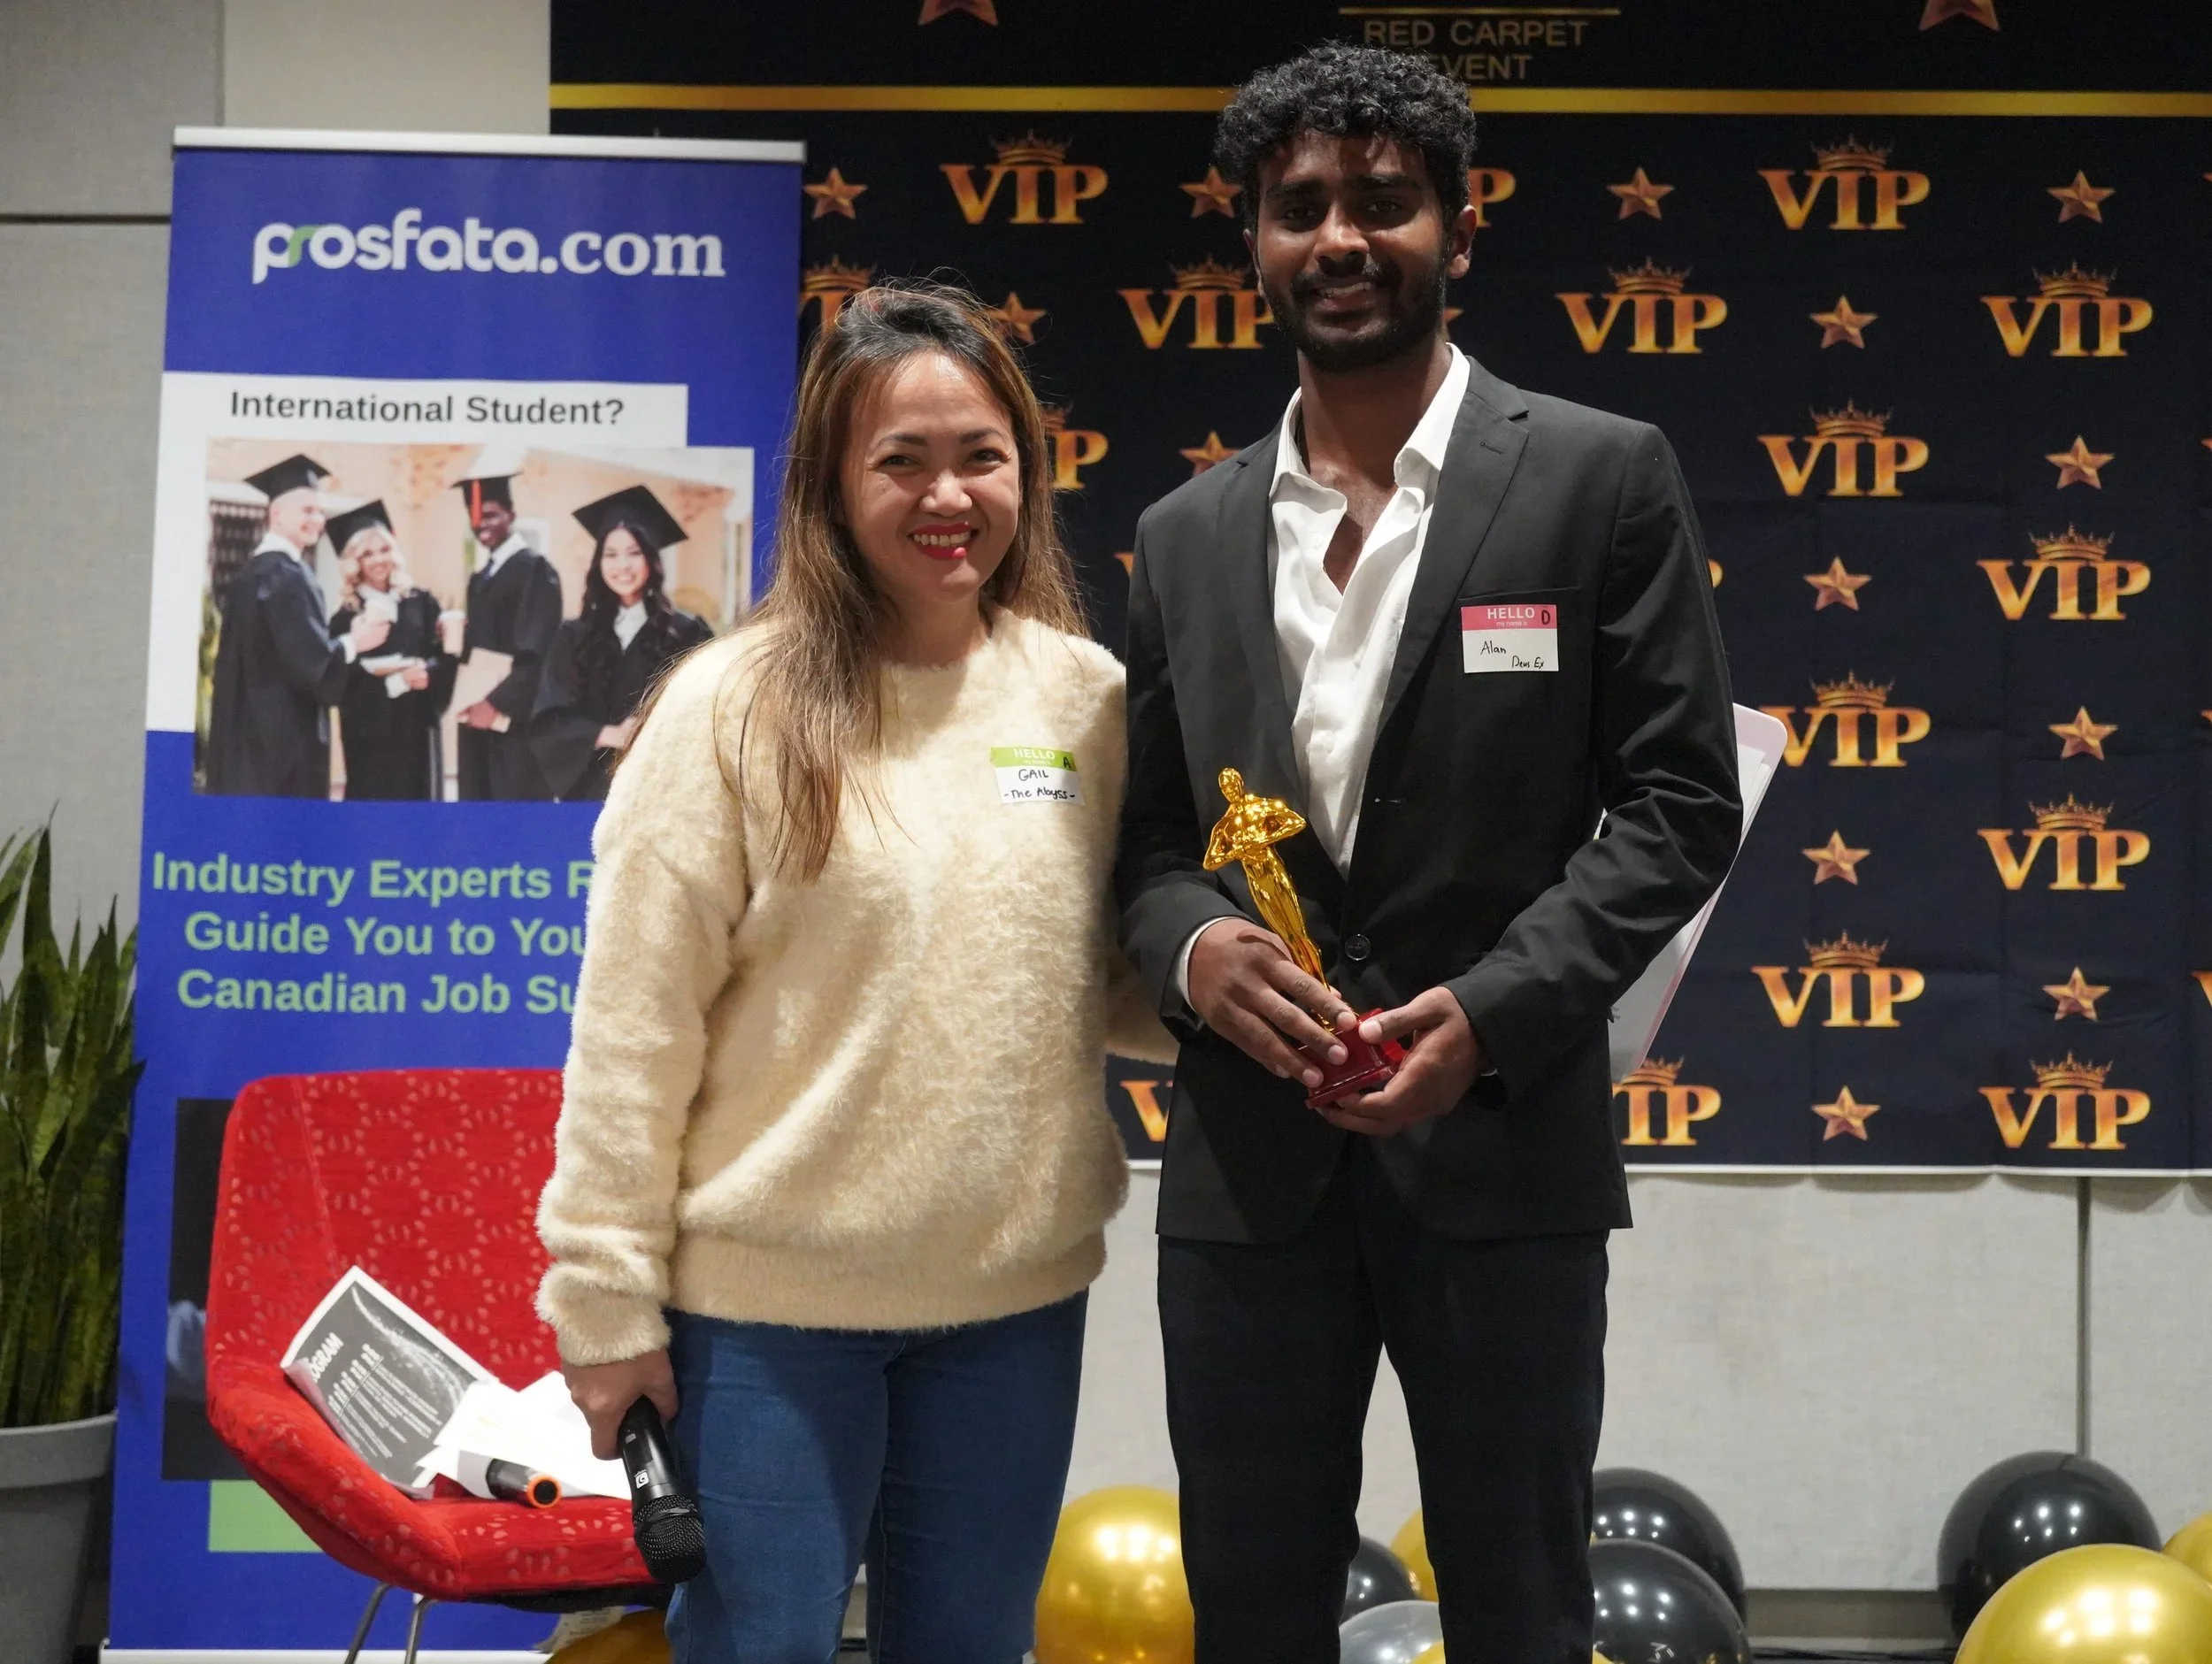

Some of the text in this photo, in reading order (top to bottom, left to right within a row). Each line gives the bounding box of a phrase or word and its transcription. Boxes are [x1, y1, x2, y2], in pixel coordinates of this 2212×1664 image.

[1363, 19, 1589, 48] RED CARPET
[940, 165, 1108, 225] VIP
[1757, 169, 1931, 230] VIP
[253, 208, 725, 284] prosfata.com
[1555, 293, 1728, 354] VIP
[1980, 296, 2153, 357] VIP
[231, 391, 624, 425] International Student?
[1757, 435, 1930, 497] VIP
[1487, 607, 1535, 619] HELLO
[1977, 559, 2151, 621] VIP
[1480, 640, 1507, 655] Alan
[1013, 748, 1056, 760] HELLO
[1760, 706, 1932, 768] VIP
[1018, 769, 1049, 782] GAIL
[152, 851, 355, 908] Industry
[369, 859, 552, 909] Experts
[1977, 829, 2151, 891] VIP
[184, 910, 585, 956] Guide You to You
[177, 969, 574, 1015] Canadian Job Su
[1752, 966, 1925, 1029] VIP
[1613, 1083, 1722, 1146] IP
[1978, 1086, 2152, 1149] VIP
